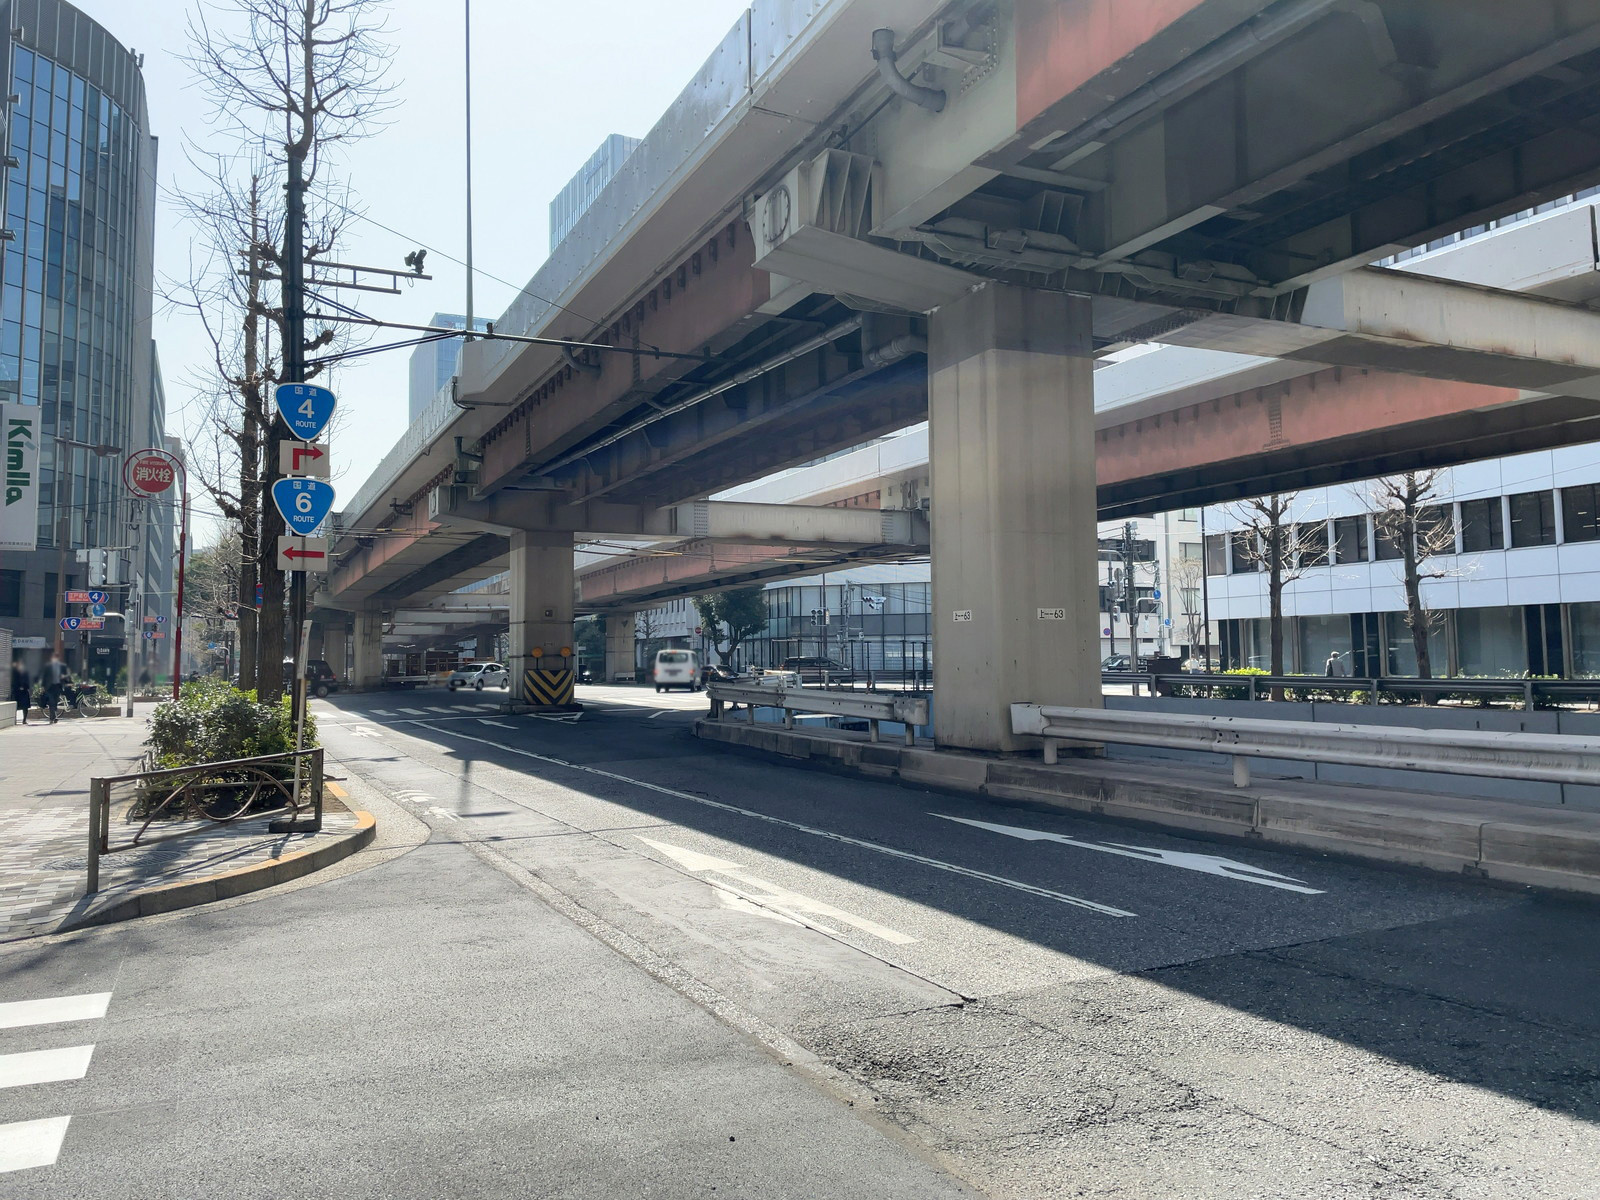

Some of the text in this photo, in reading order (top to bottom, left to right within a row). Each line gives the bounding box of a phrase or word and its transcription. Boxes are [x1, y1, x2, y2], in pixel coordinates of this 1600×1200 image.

[295, 386, 317, 397] 国道
[298, 399, 315, 419] 4
[295, 420, 317, 429] ROUTE
[136, 466, 171, 483] 消火栓
[293, 481, 316, 491] 国道
[295, 492, 312, 513] 6
[293, 515, 315, 523] ROUTE
